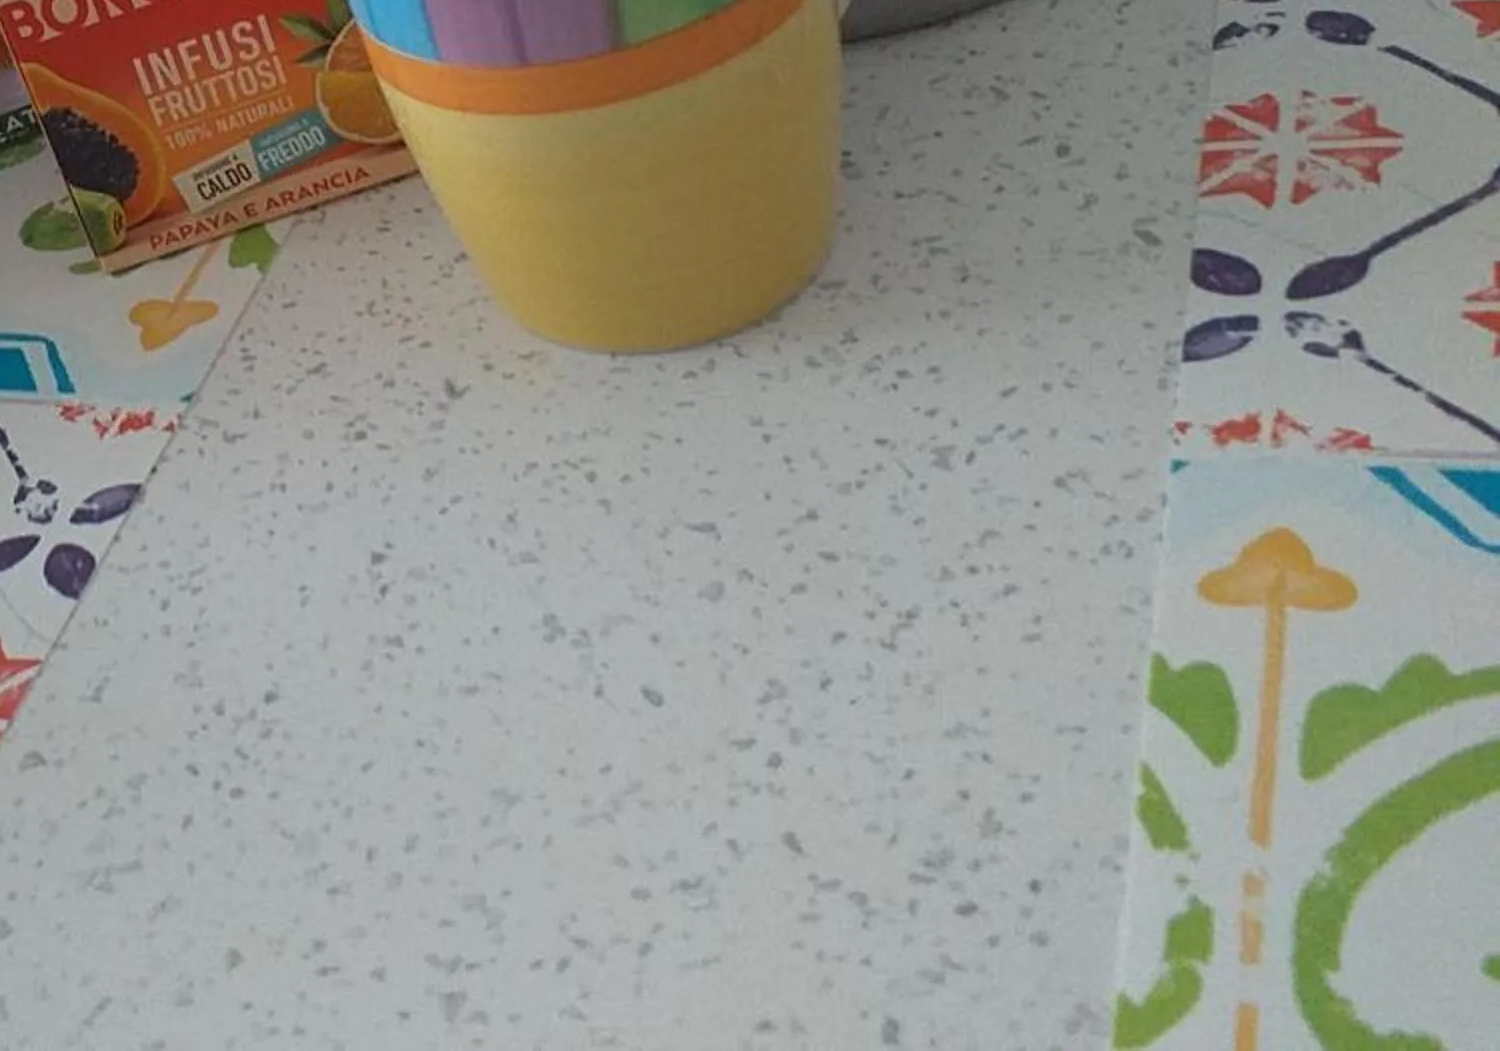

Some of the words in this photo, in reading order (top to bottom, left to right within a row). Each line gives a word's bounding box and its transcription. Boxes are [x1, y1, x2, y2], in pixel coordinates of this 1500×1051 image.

[132, 13, 278, 96] INFUSI
[147, 53, 288, 128] FRUTTOSI
[164, 122, 213, 150] 100%
[214, 96, 296, 134] NATURALI
[257, 125, 326, 172] FREDDO
[149, 210, 239, 251] PAPAYA
[243, 202, 260, 219] E
[263, 164, 373, 212] ARANCIA
[196, 162, 252, 200] CALDO
